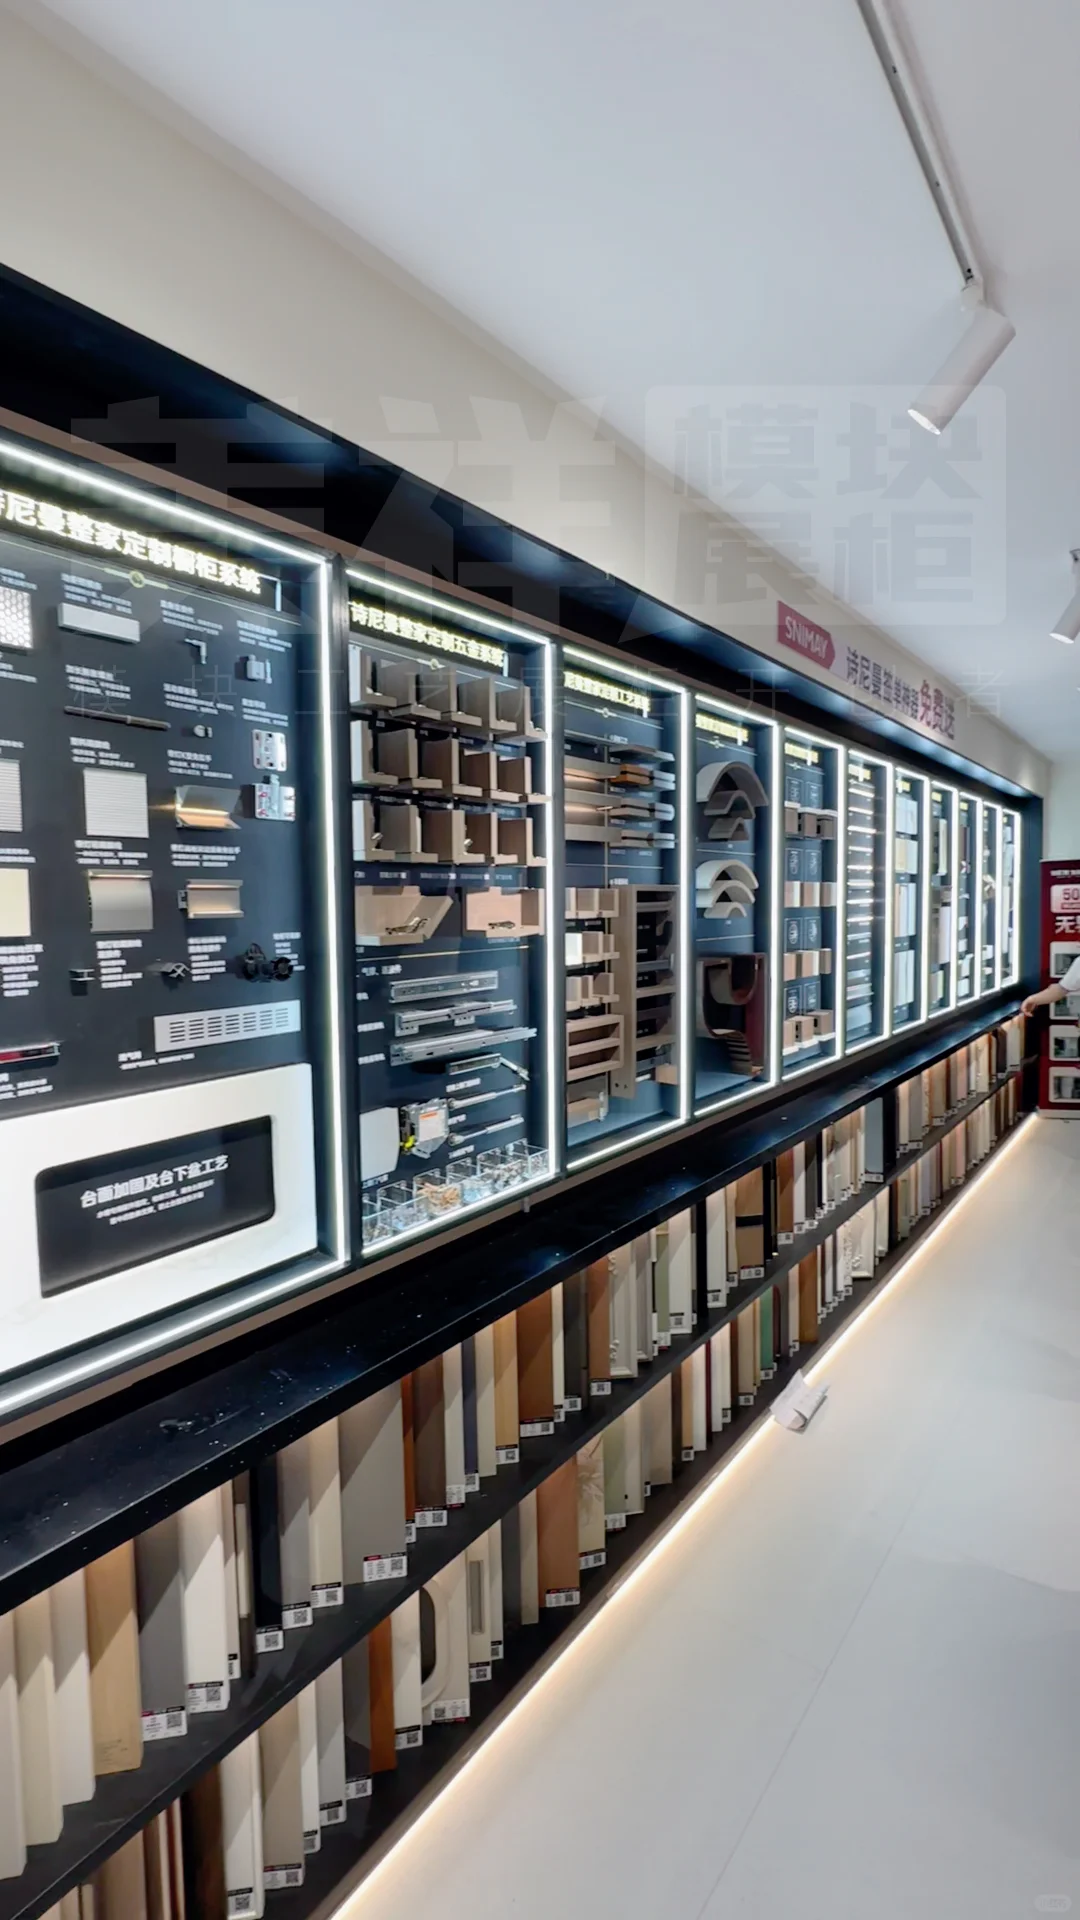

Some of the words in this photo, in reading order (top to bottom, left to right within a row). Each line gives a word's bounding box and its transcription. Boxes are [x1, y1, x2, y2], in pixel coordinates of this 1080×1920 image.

[785, 615, 829, 660] SNIMAY
[79, 1154, 229, 1208] 台面加固及台下盆工艺
